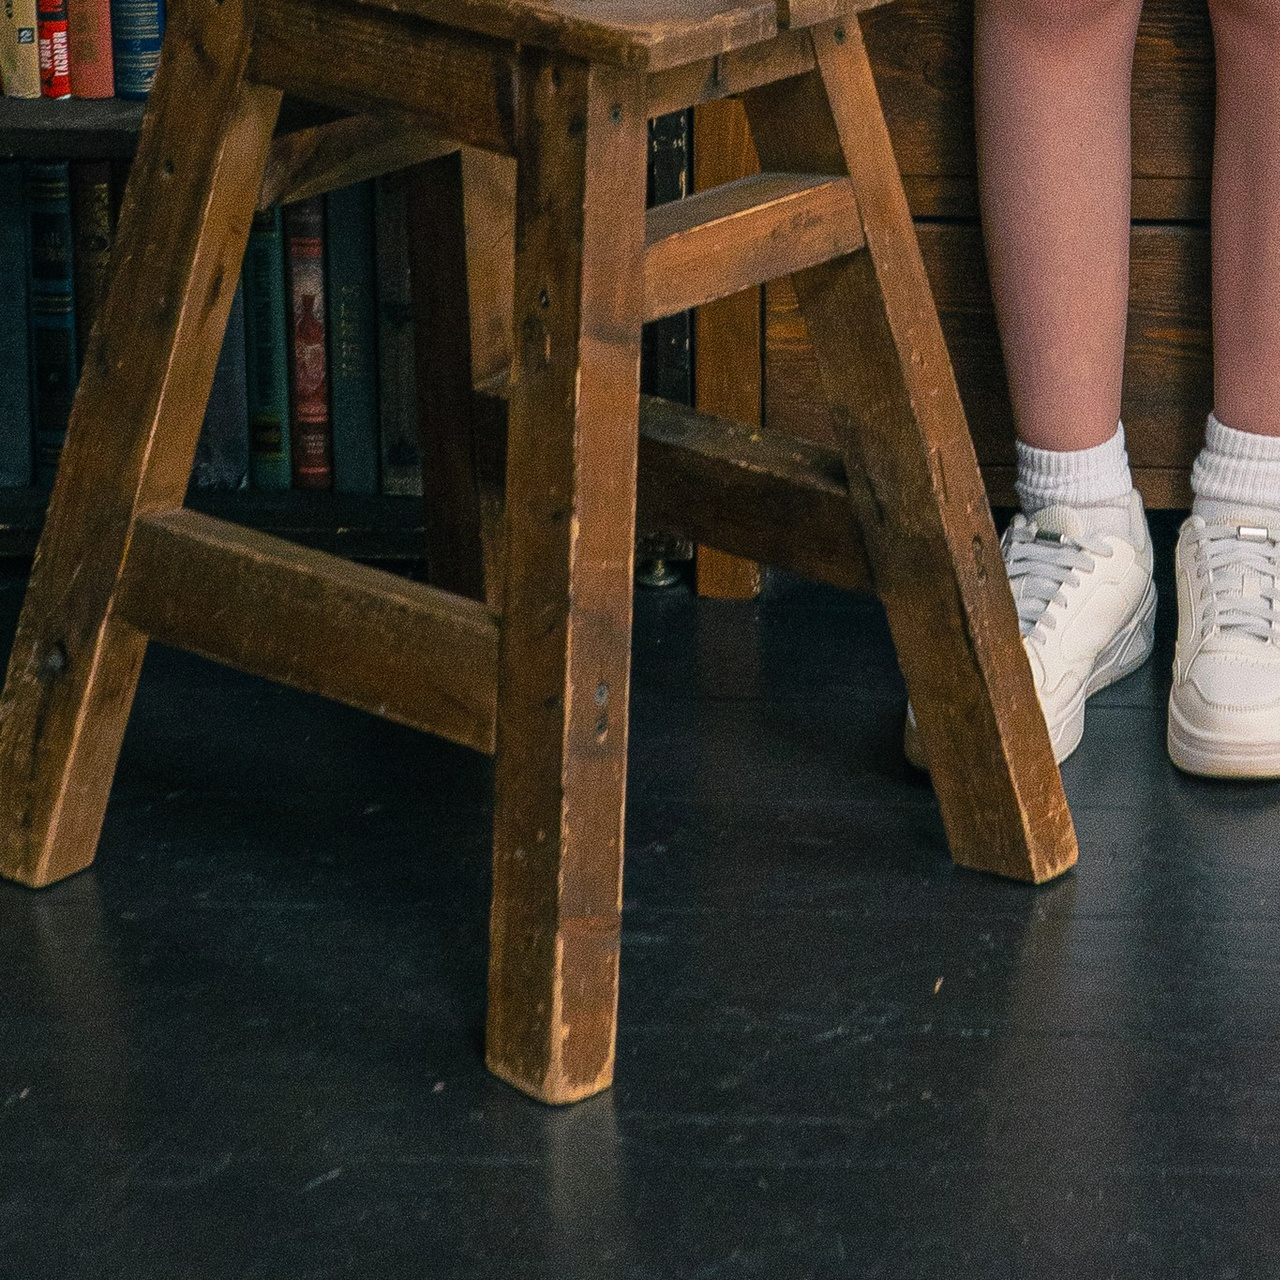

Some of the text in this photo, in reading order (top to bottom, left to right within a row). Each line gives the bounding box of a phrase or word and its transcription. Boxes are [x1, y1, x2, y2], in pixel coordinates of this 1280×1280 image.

[20, 29, 32, 43] 2
[39, 38, 53, 69] АРМЕН
[53, 31, 69, 77] ГАСПАРЯН
